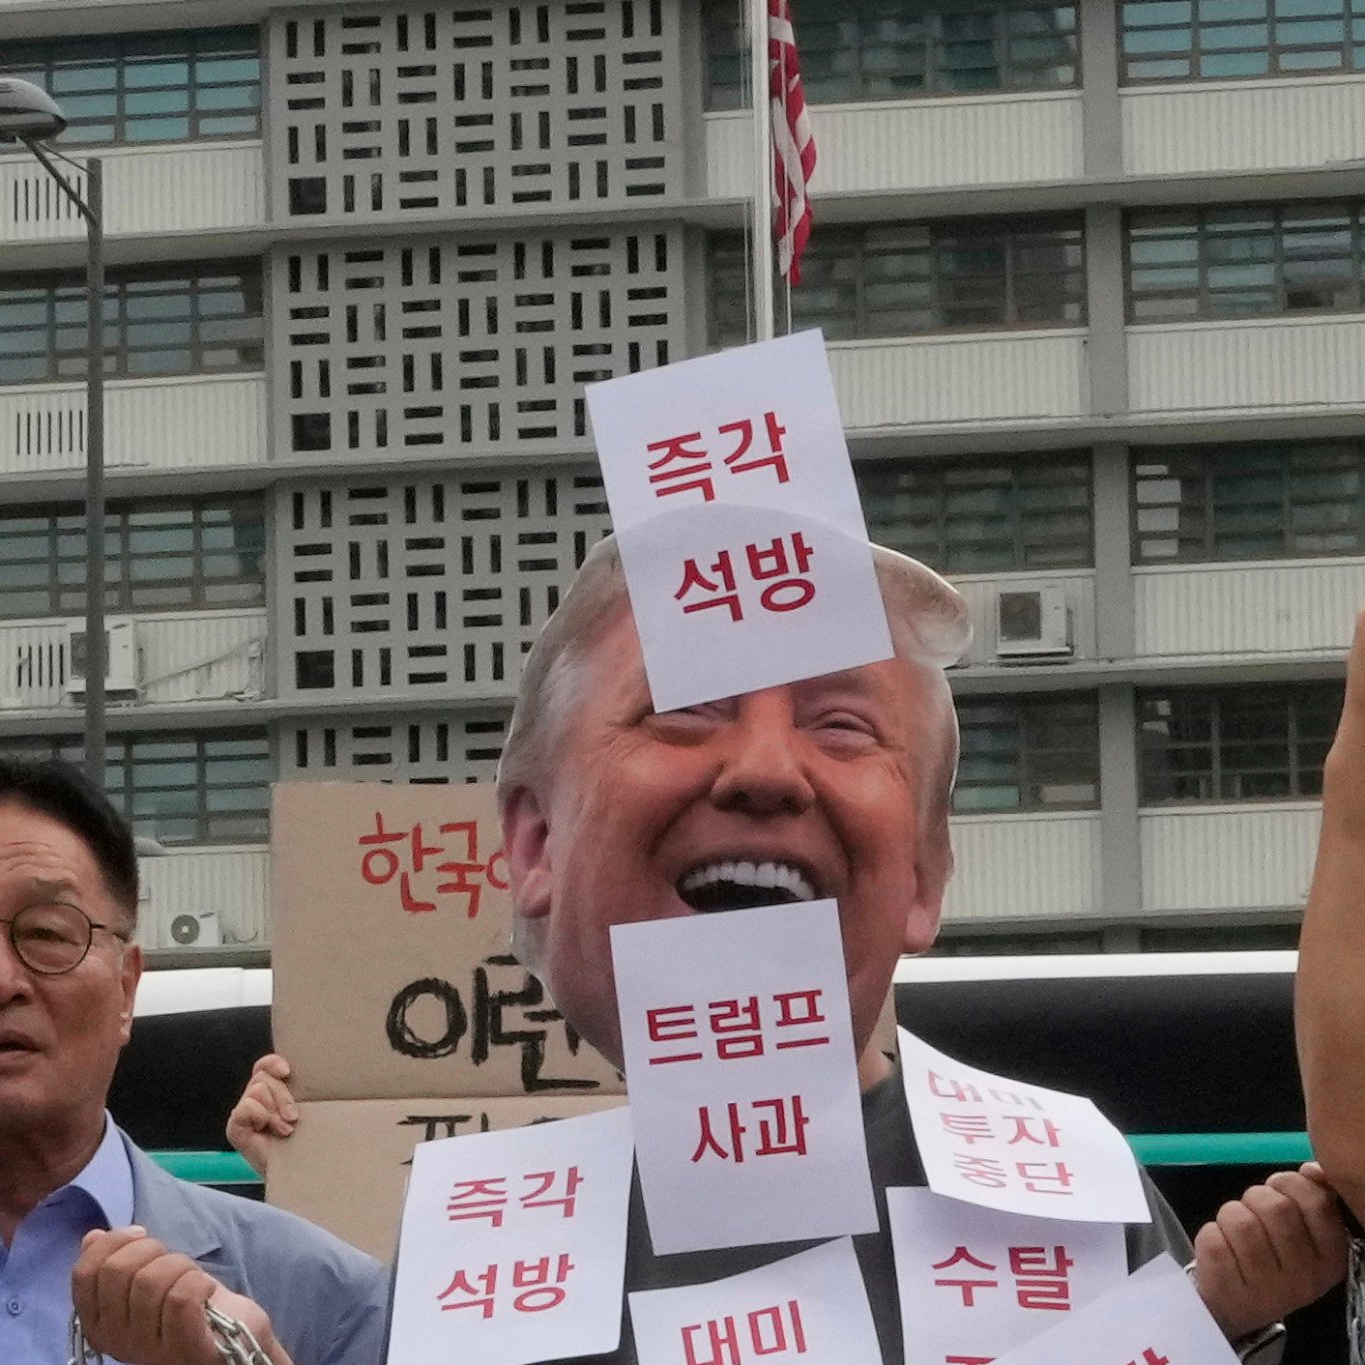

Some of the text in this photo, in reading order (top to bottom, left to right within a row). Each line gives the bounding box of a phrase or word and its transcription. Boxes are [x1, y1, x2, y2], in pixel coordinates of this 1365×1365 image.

[647, 411, 790, 502] 즉각
[674, 531, 816, 622] 석방
[358, 811, 513, 918] 한국
[646, 989, 829, 1065] 트럼프
[691, 1095, 809, 1163] 사과
[939, 1112, 1062, 1148] 투자
[446, 1165, 584, 1228] 즉각
[953, 1153, 1075, 1196] 중단
[436, 1253, 575, 1319] 석방
[932, 1244, 1073, 1311] 수탈
